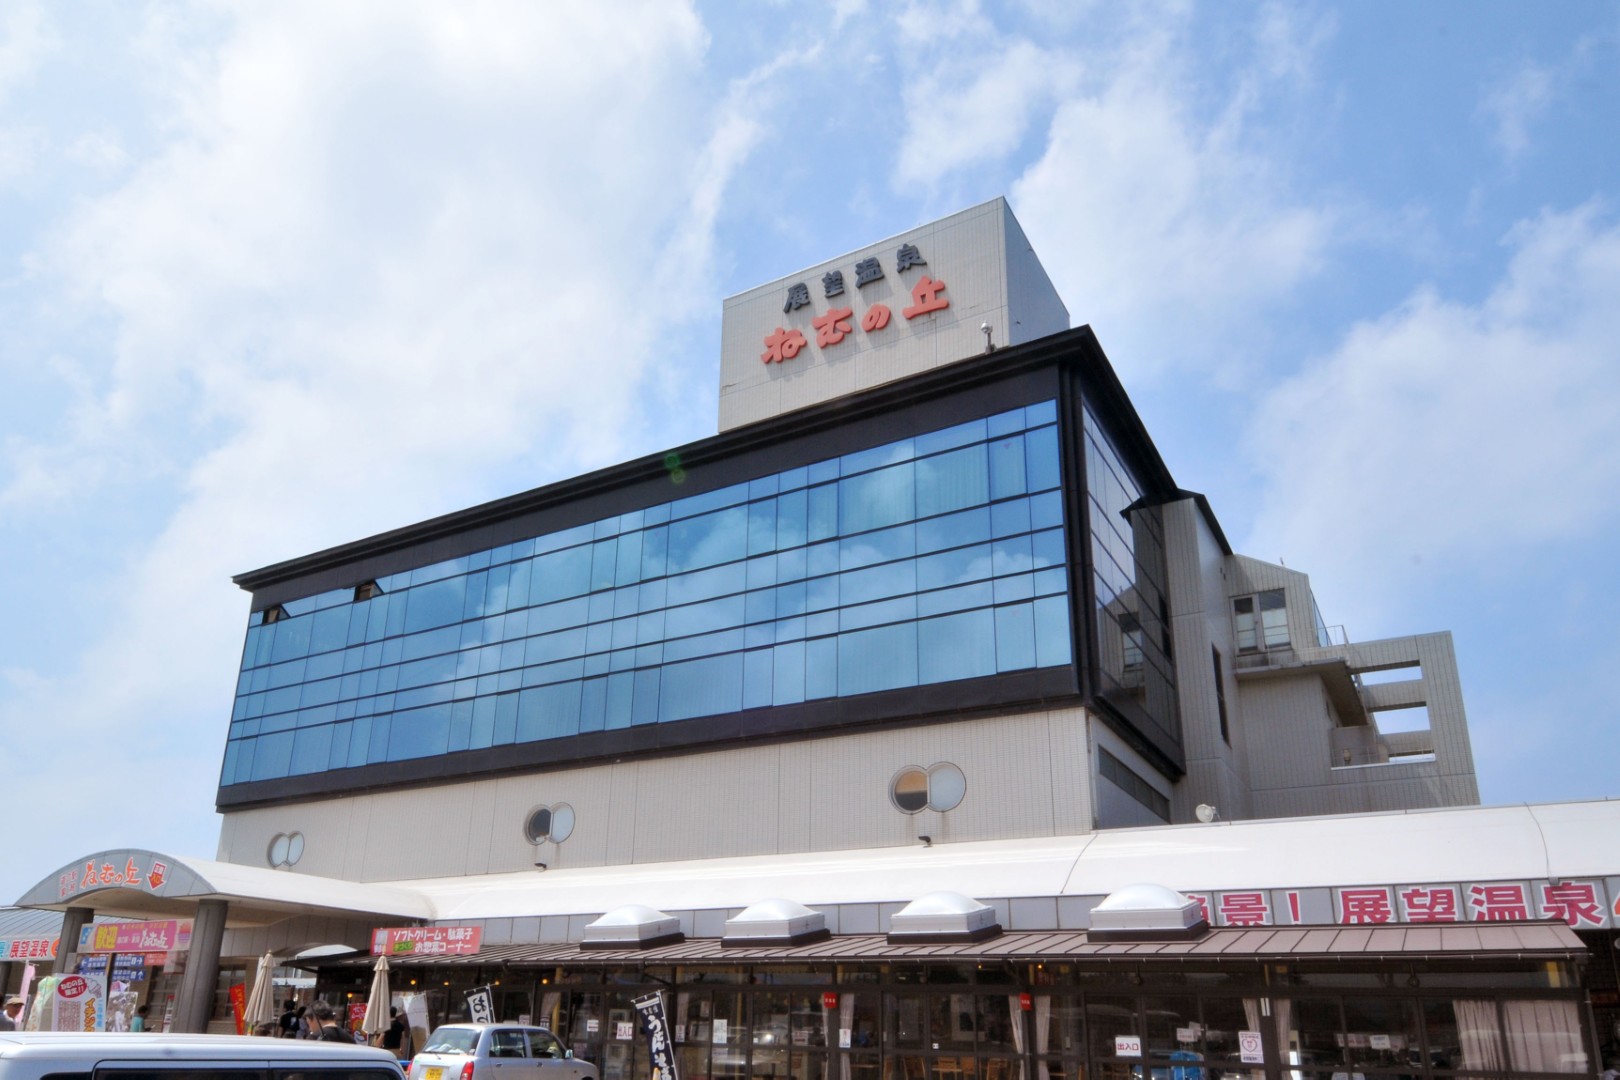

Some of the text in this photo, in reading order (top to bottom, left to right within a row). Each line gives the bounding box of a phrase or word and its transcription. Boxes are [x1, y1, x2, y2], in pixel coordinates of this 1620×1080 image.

[783, 243, 928, 313] 展望温泉
[760, 275, 949, 364] ねむの丘
[80, 856, 143, 889] ねむの丘
[1341, 879, 1610, 927] 展望温泉
[393, 927, 473, 941] ソフトクリーム・駄菓子
[414, 941, 472, 953] お惣菜コーナー
[9, 939, 49, 958] 展望温泉
[1116, 1042, 1139, 1052] 出入口
